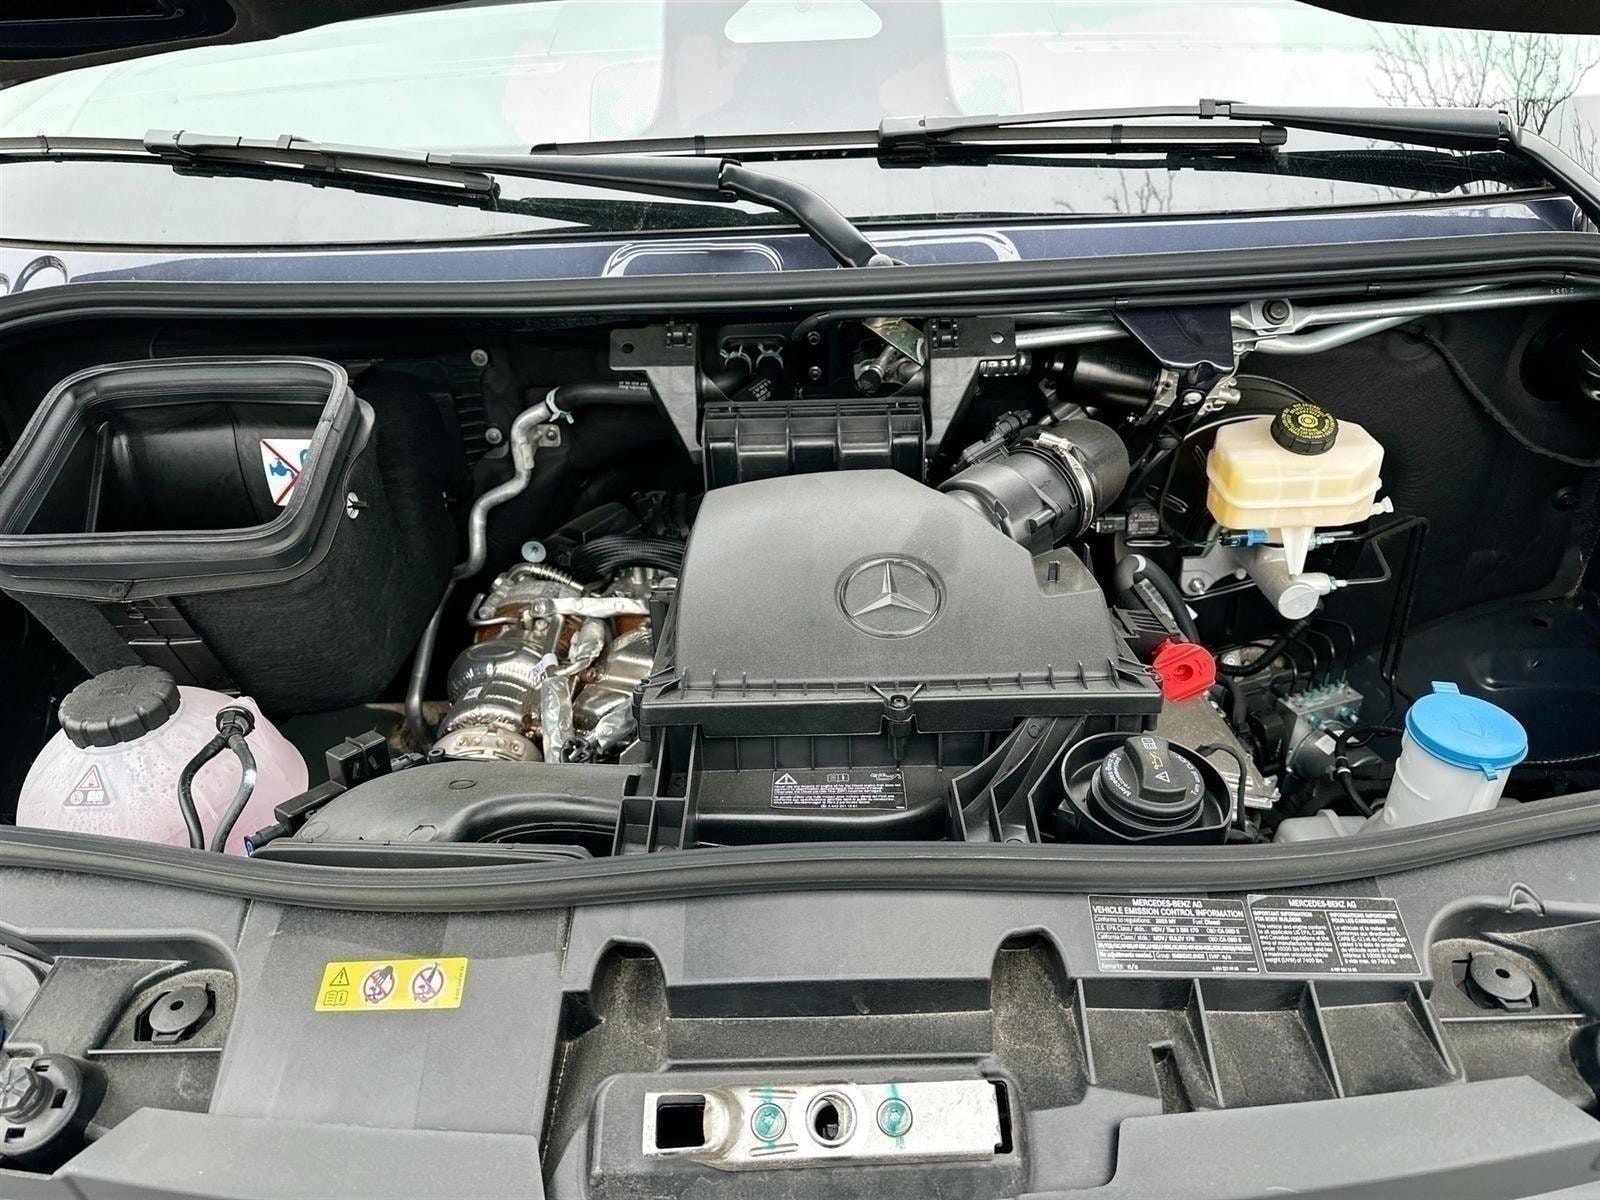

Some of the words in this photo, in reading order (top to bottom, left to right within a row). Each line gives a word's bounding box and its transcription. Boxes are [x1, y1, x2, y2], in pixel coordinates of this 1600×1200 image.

[1132, 899, 1191, 908] MERCEDES-BENZ
[1288, 900, 1346, 908] MERCEDES-BENZ
[1092, 906, 1123, 914] VEHICLE
[1124, 907, 1159, 915] EMISSION
[1160, 908, 1195, 916] CONTROL
[1195, 909, 1244, 917] INFORMATION
